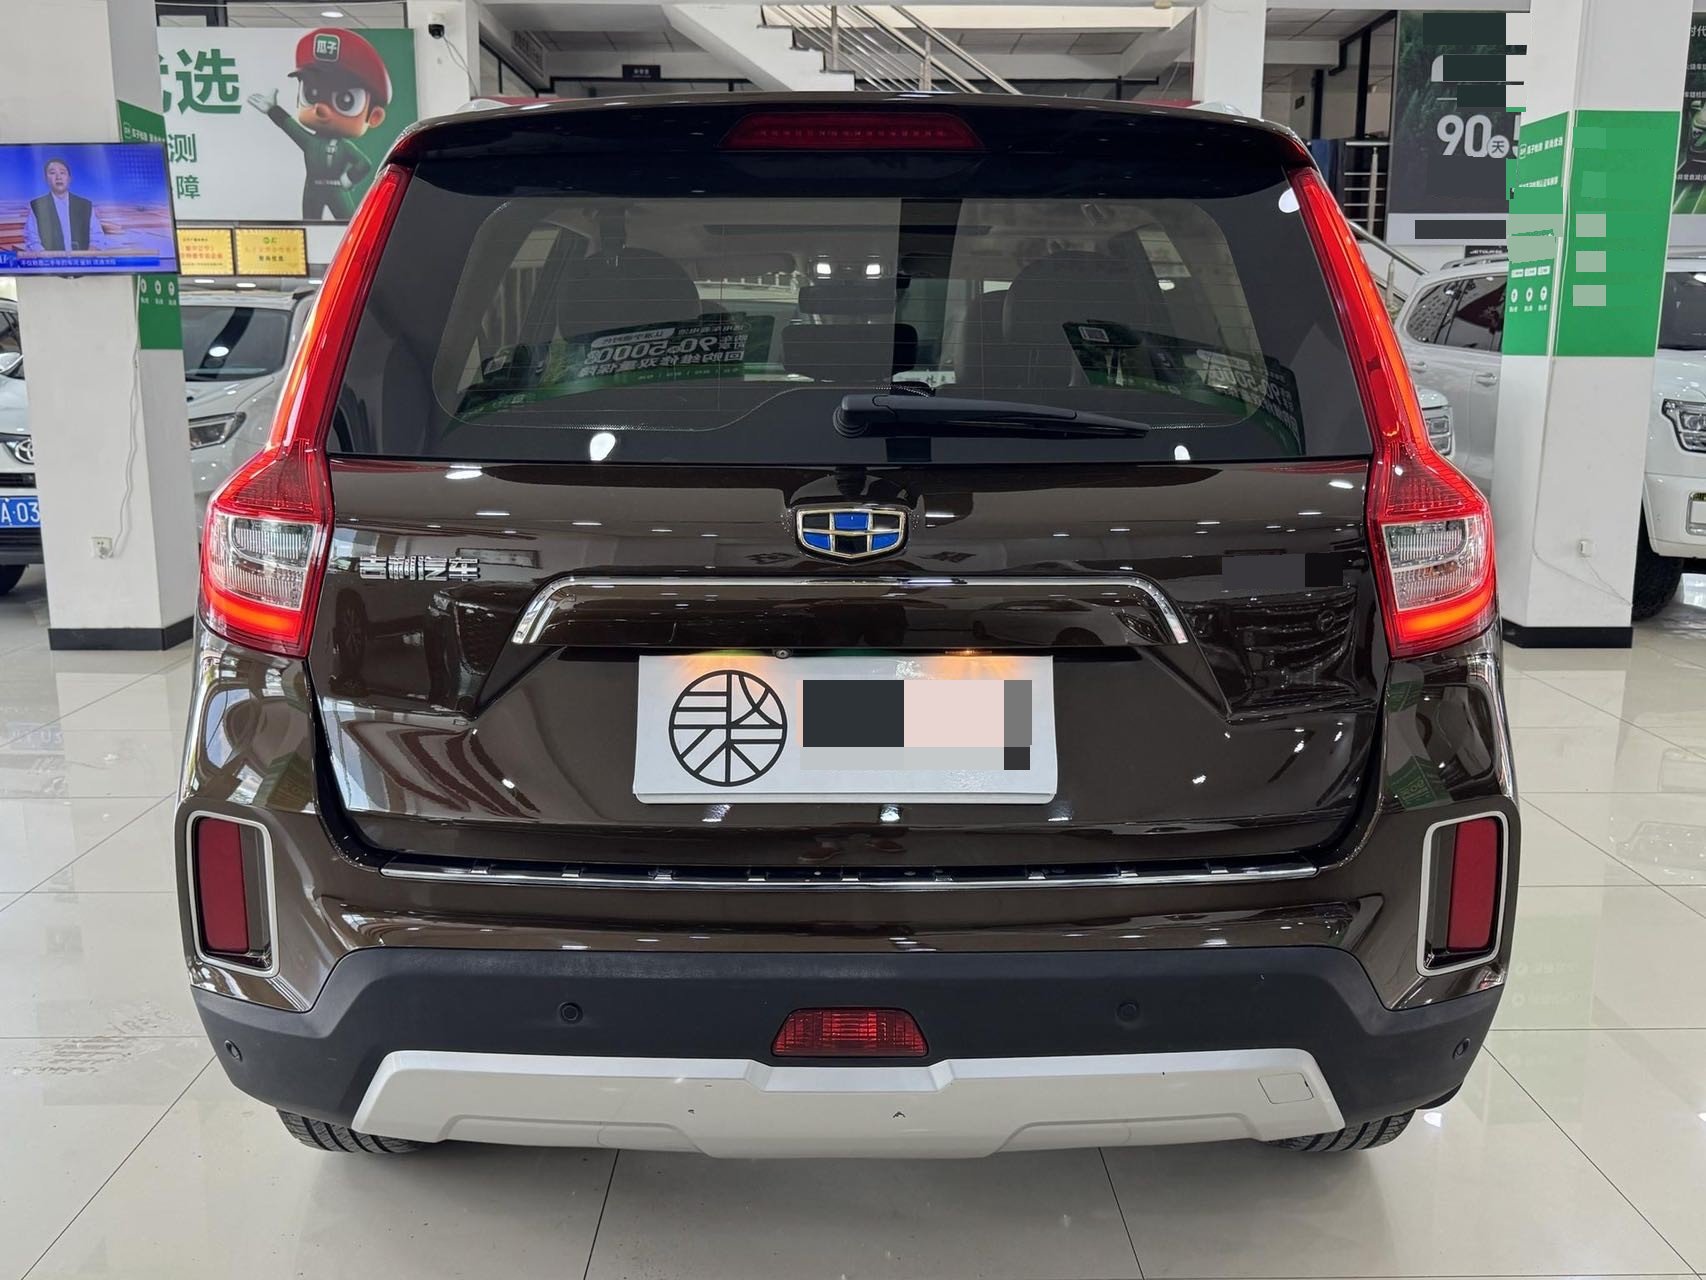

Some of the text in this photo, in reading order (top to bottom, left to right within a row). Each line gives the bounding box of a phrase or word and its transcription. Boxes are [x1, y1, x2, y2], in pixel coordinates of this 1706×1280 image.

[317, 40, 337, 55] 瓜子
[360, 555, 481, 581] 吉利汽车
